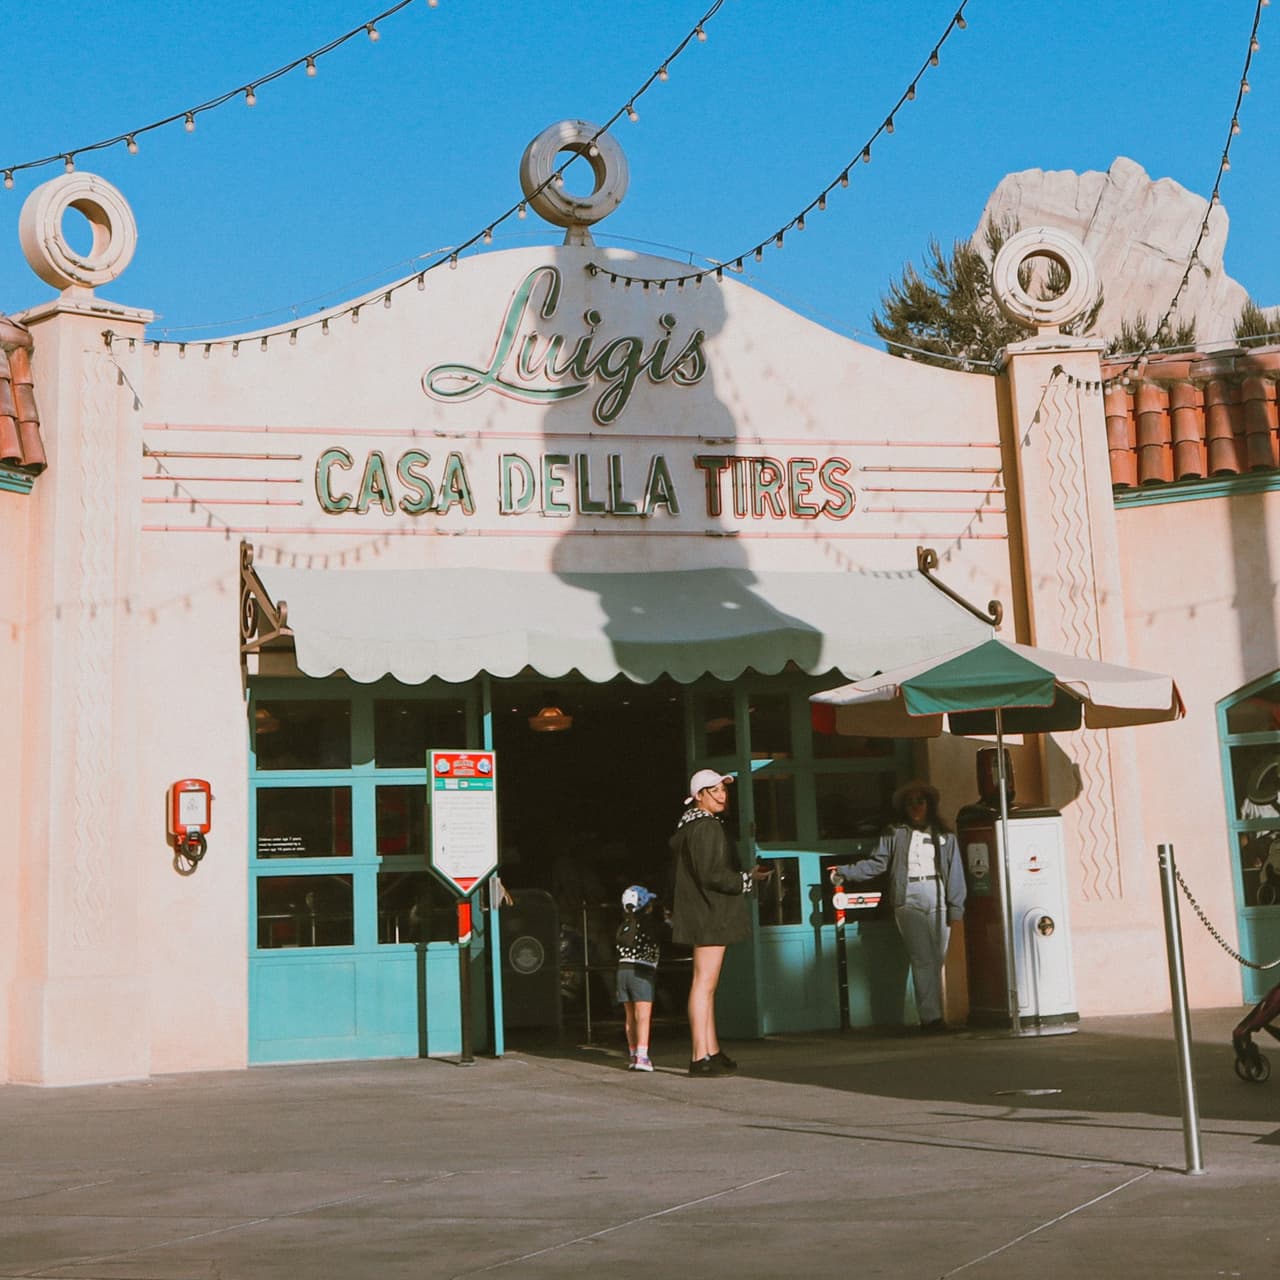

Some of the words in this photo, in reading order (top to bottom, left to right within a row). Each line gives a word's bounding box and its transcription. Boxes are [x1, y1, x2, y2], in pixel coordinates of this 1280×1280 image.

[315, 446, 477, 517] CASA
[498, 452, 681, 518] DELLA
[693, 455, 857, 521] TIRES
